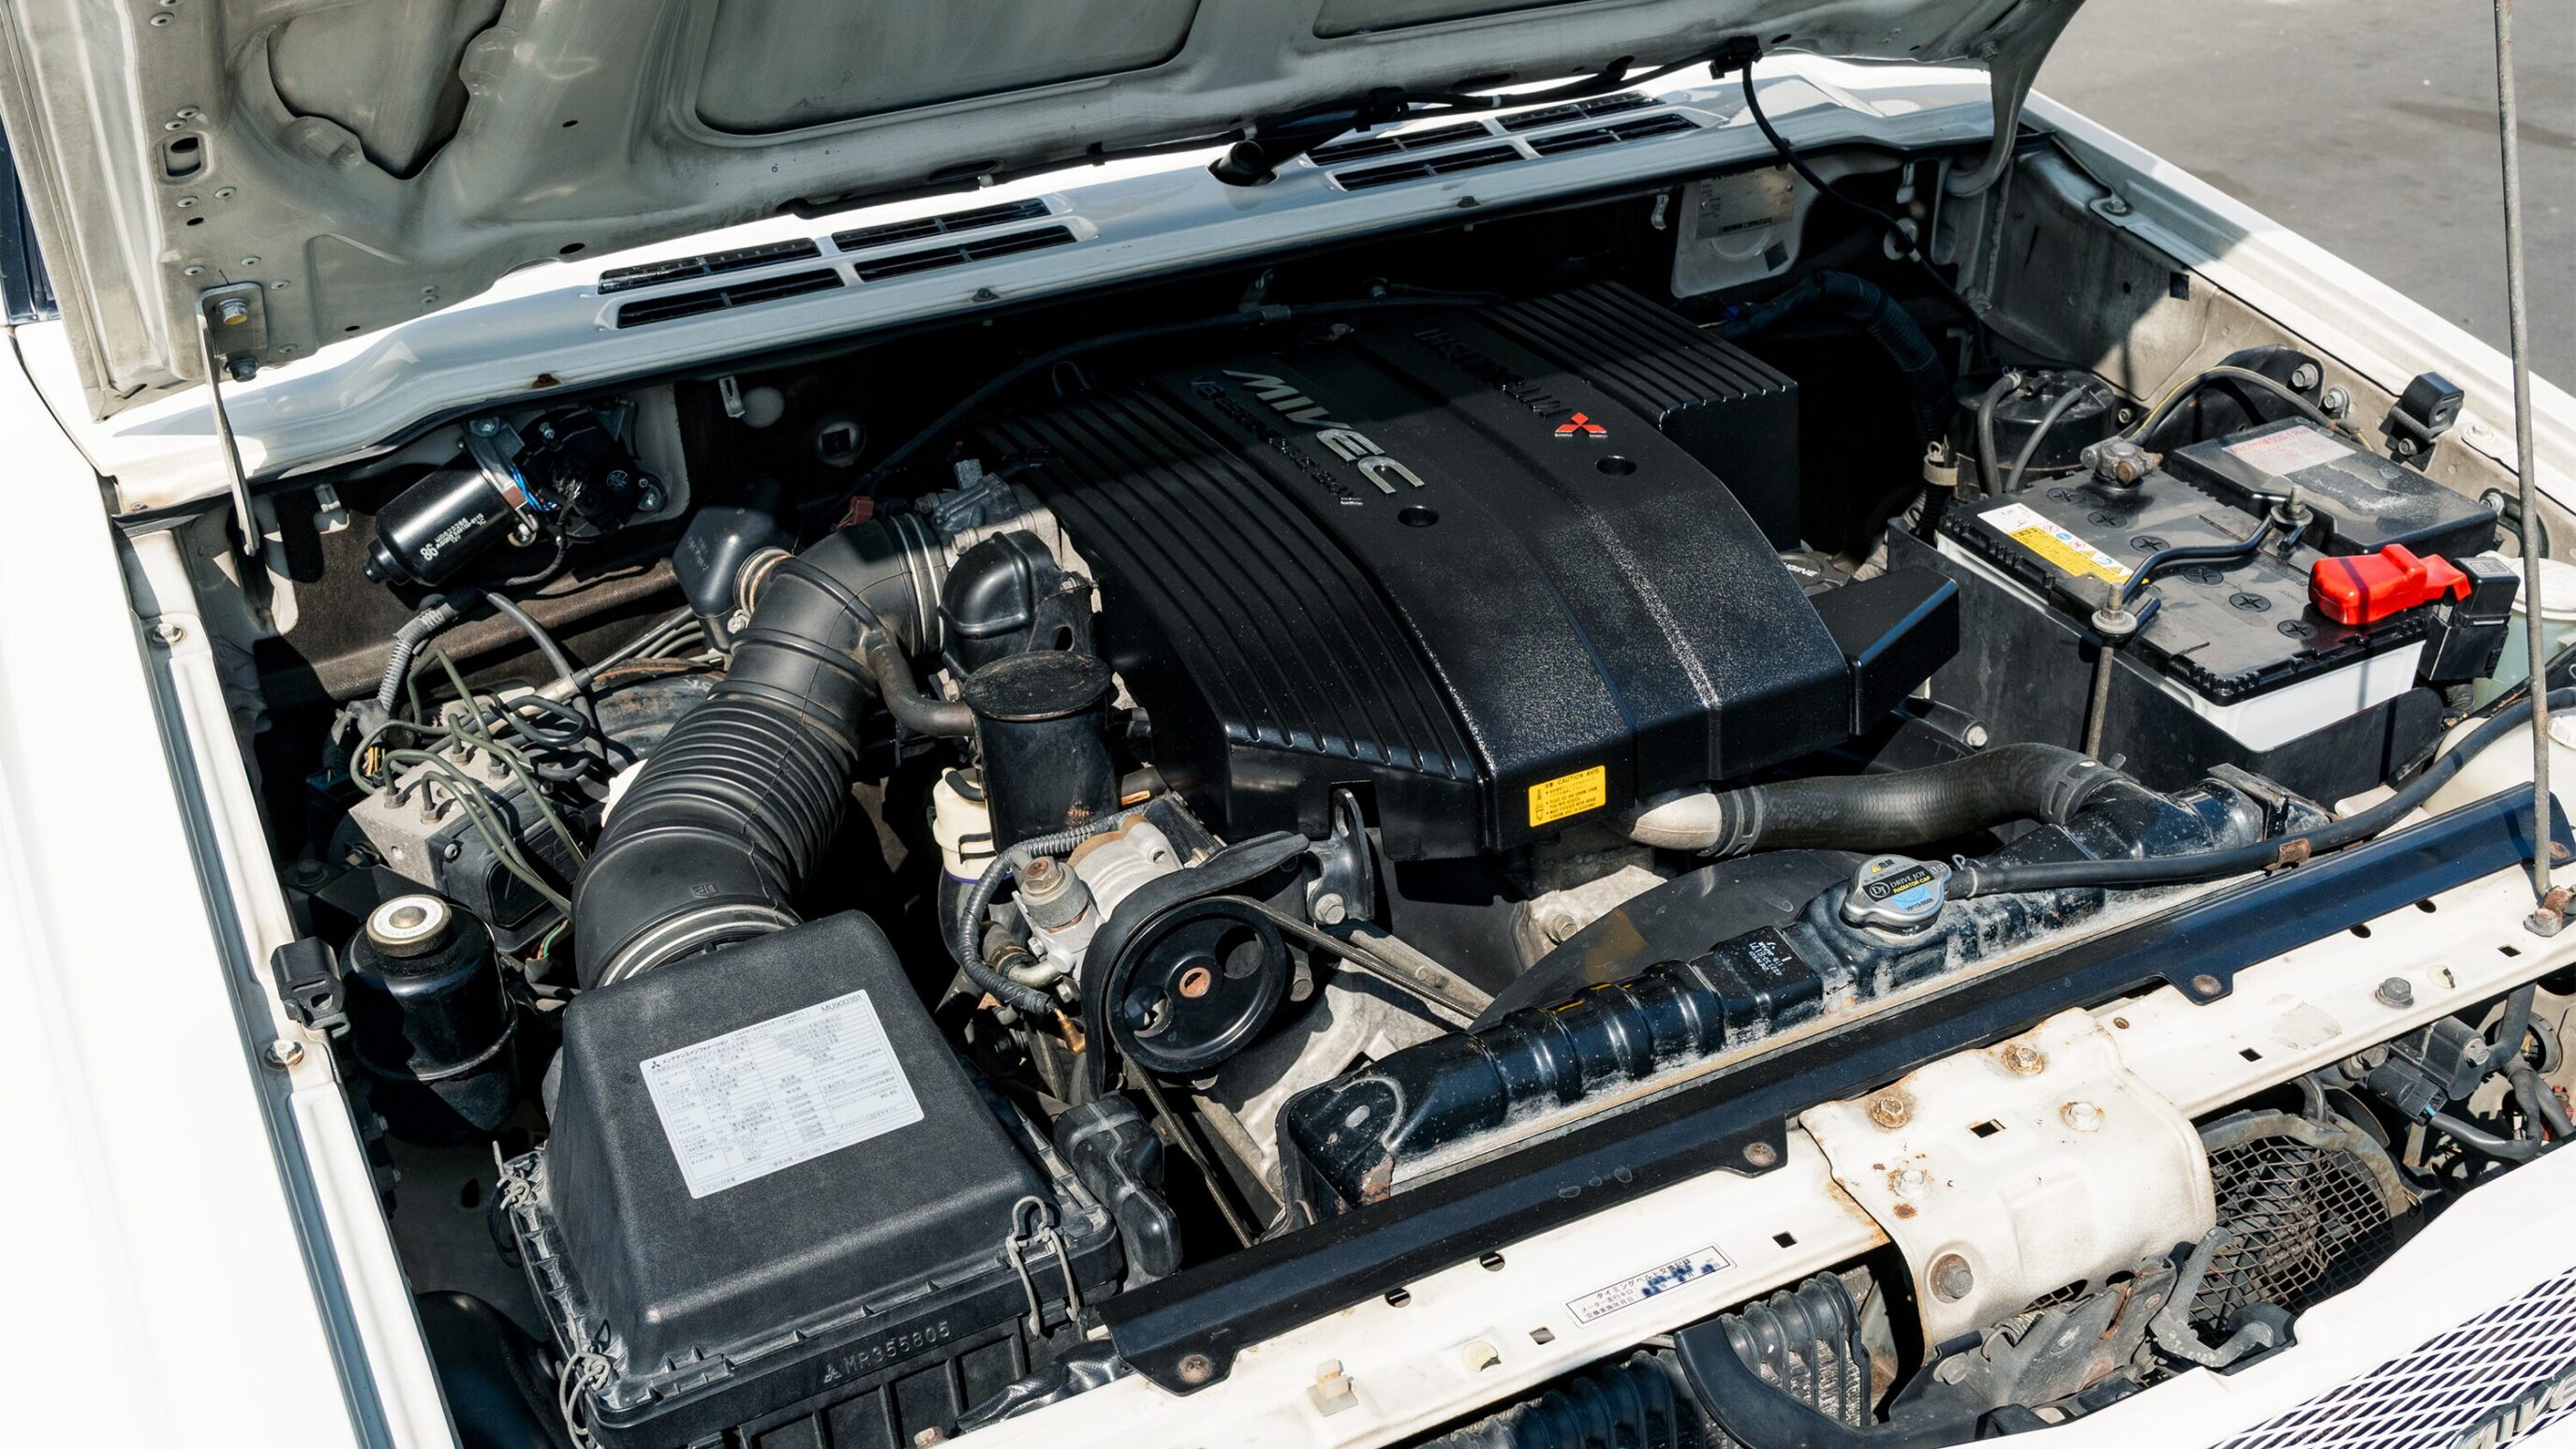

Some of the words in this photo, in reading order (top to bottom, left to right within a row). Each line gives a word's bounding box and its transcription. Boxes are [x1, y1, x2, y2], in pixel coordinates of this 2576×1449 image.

[1221, 369, 1426, 495] MIVEC
[420, 543, 439, 561] 86
[1557, 773, 1584, 785] CAUTION
[1586, 768, 1600, 776] AVIS
[1889, 876, 1912, 888] DRIVE
[1912, 870, 1926, 881] JOY
[1892, 880, 1920, 894] RADIATOR
[1919, 876, 1932, 884] CAP
[821, 994, 862, 1013] MU900351
[1596, 1257, 1692, 1299] タイミングベルト交換記録
[843, 1321, 951, 1375] MR355805
